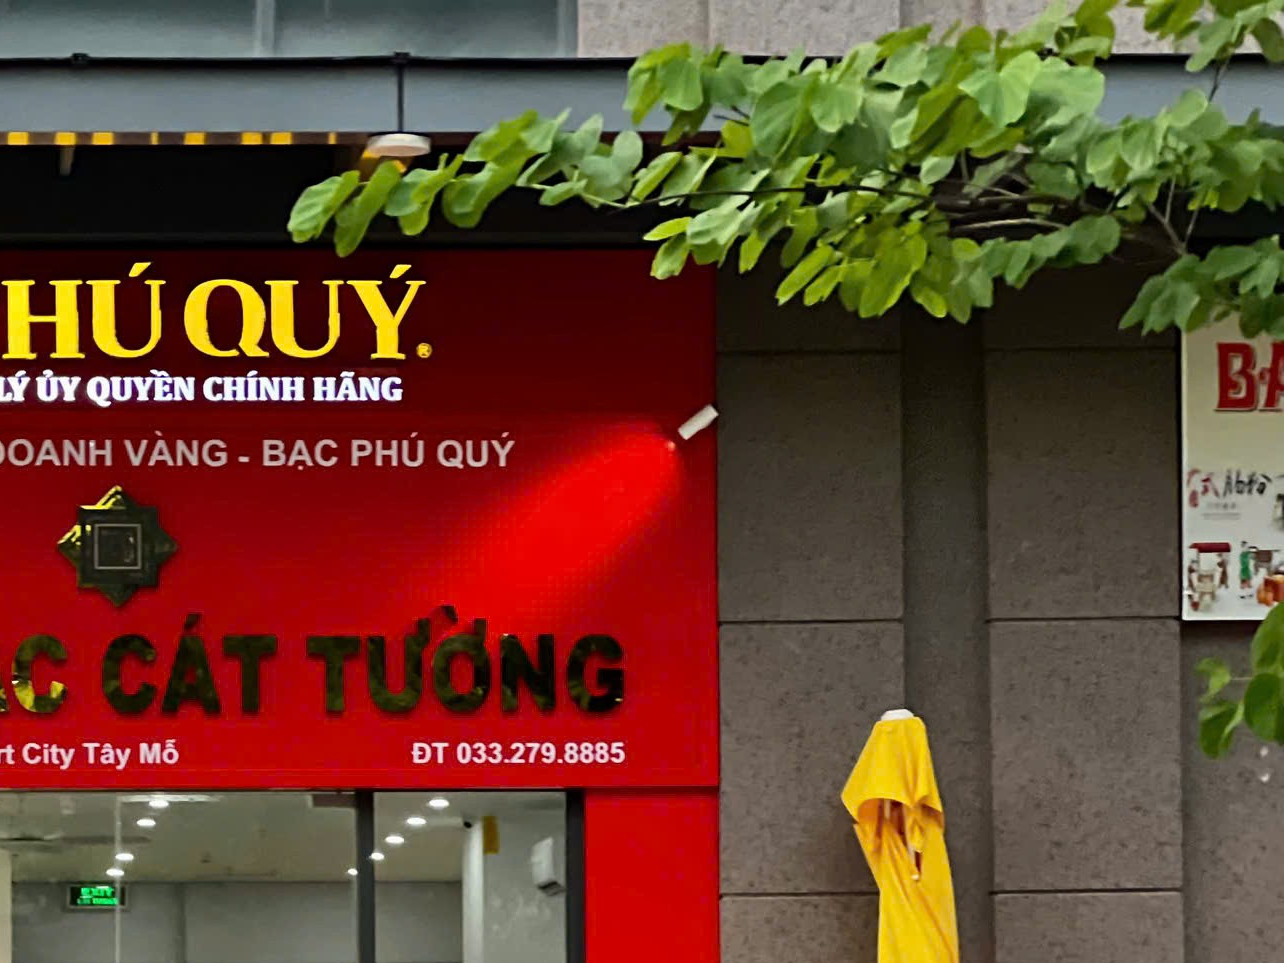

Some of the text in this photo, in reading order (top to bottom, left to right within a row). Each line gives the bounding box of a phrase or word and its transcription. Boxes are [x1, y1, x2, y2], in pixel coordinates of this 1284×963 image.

[183, 264, 426, 360] QUÝ
[36, 369, 81, 402] ỦY
[86, 369, 196, 408] QUYỀN
[203, 370, 306, 402] CHÍNH
[312, 371, 404, 402] HÃNG
[124, 430, 229, 467] VÀNG
[262, 439, 339, 471] BẠC
[351, 432, 424, 467] PHÚ
[437, 432, 515, 469] QUÝ
[101, 614, 278, 714] CÁT
[307, 605, 625, 714] TƯỜNG
[22, 742, 75, 770] City
[82, 743, 131, 769] Tây
[139, 739, 179, 765] Mỗ
[411, 742, 626, 764] ĐT 033.279.8885
